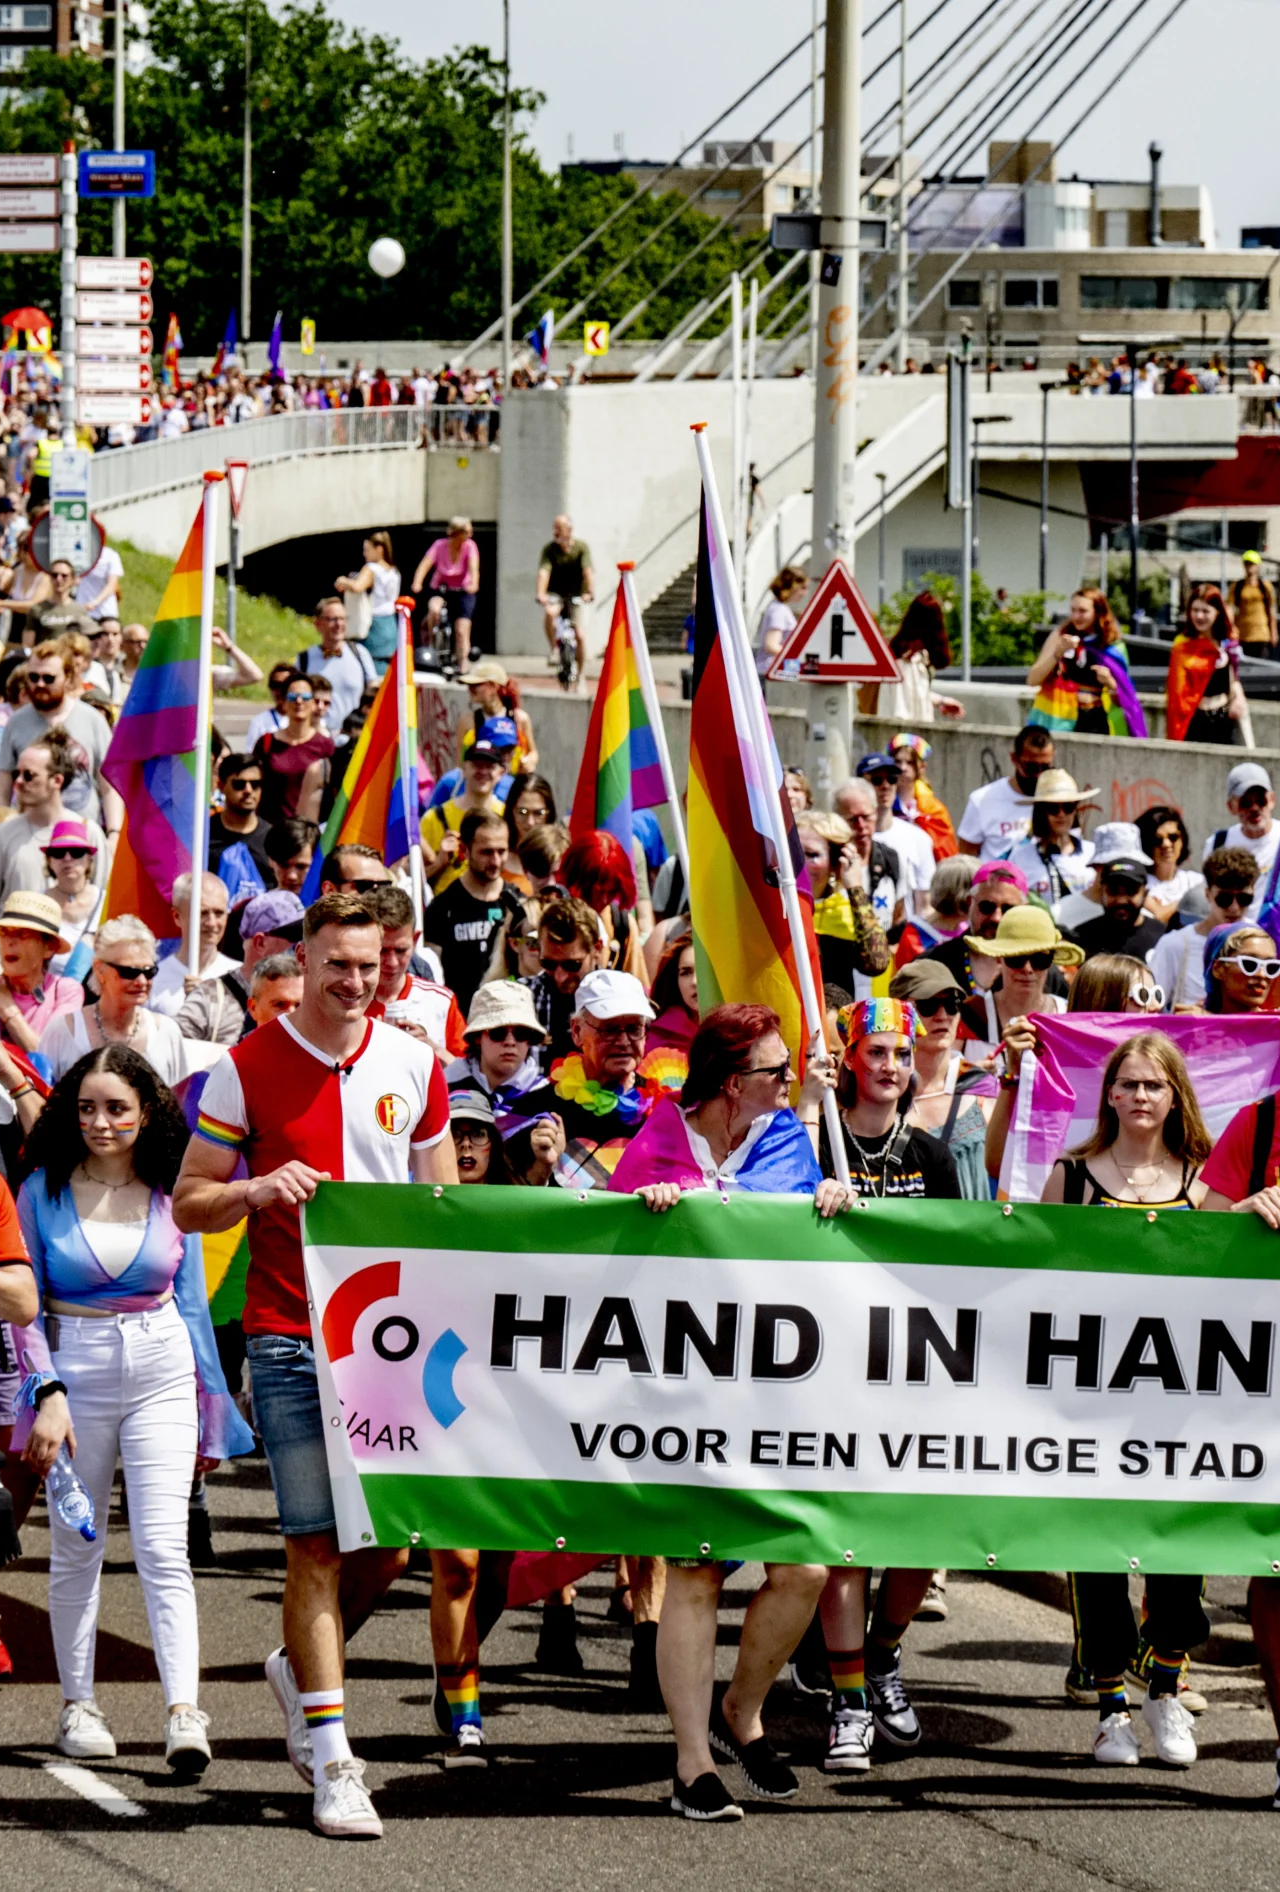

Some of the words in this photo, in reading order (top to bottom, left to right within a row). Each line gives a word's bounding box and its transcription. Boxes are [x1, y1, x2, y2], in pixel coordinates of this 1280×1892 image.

[490, 1293, 823, 1384] HAND
[867, 1305, 981, 1386] IN
[570, 1422, 729, 1466] VOOR
[750, 1430, 858, 1469] EEN
[879, 1432, 1099, 1475] VEILIGE
[1118, 1439, 1266, 1480] STAD
